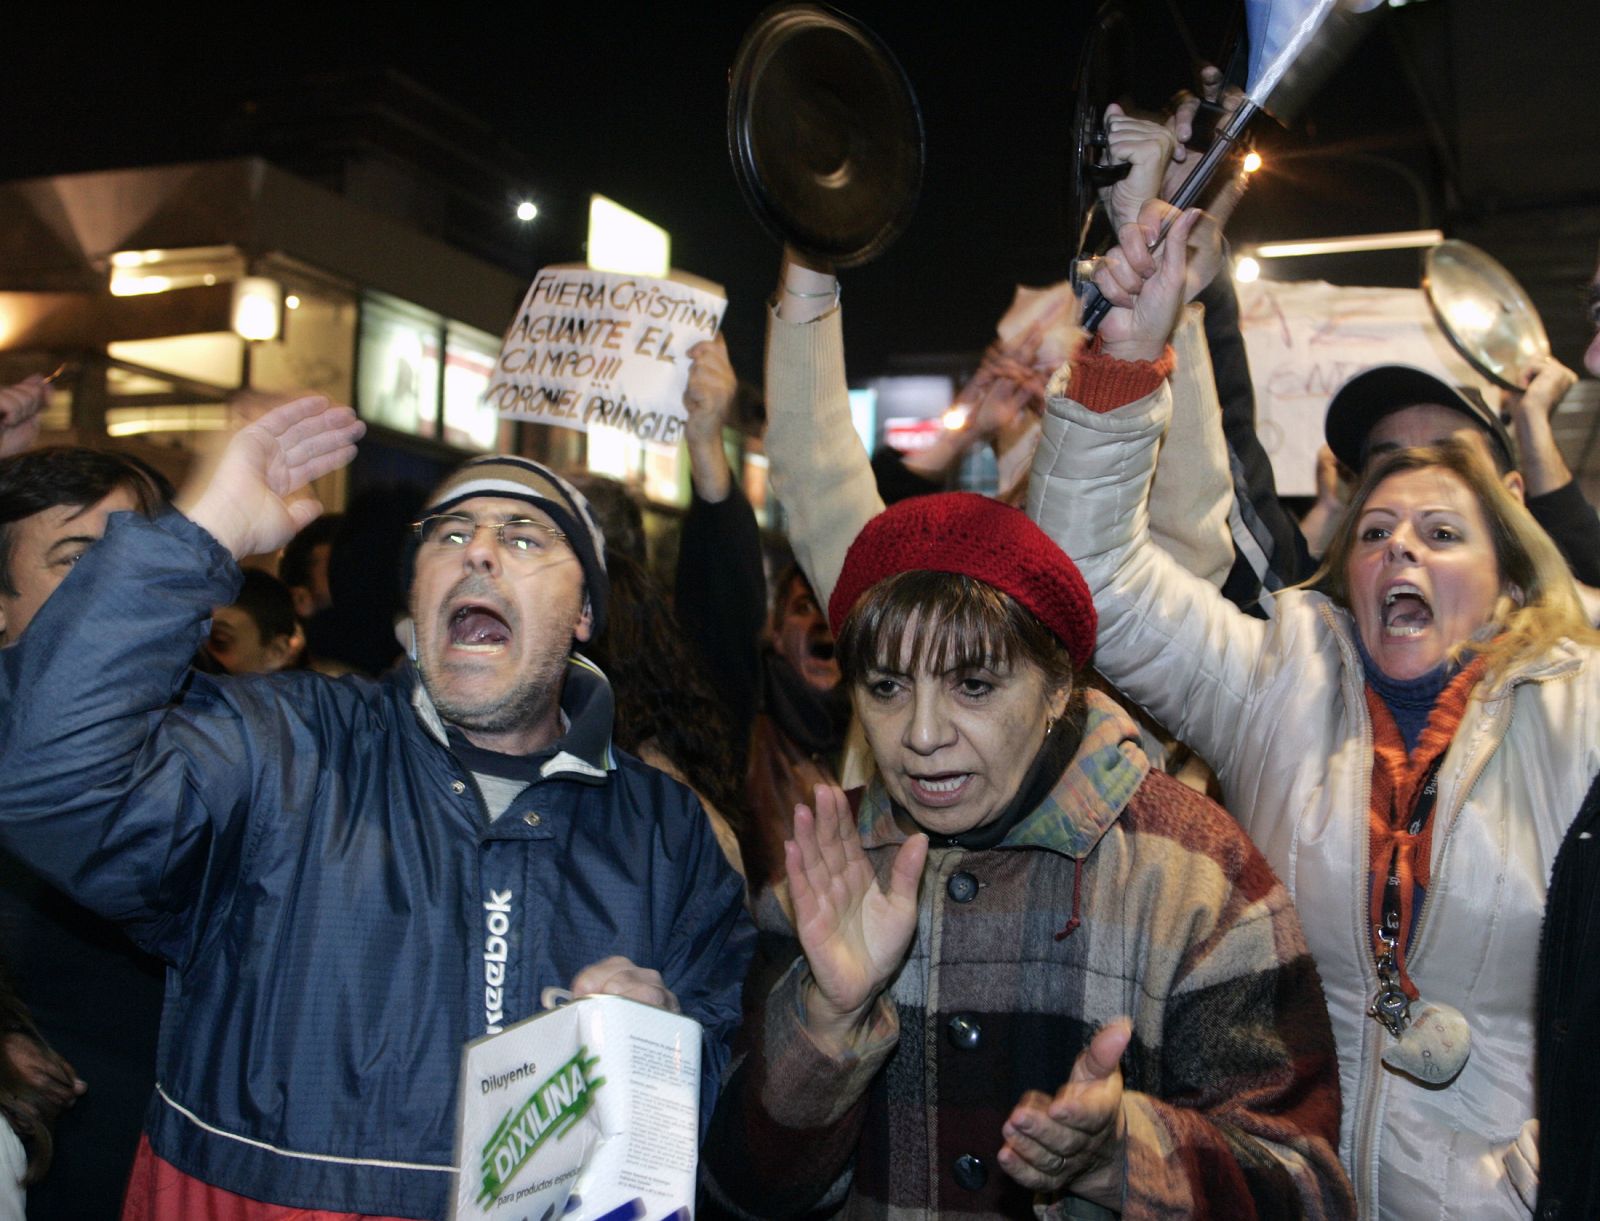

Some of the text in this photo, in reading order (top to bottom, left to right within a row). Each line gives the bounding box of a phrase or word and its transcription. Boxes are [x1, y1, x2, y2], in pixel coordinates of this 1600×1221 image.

[528, 276, 606, 309] FUERA
[510, 314, 676, 364] AGUANTE EL
[485, 383, 581, 418] CORONEL
[481, 1062, 536, 1095] Diluyente
[494, 1062, 587, 1184] DIXILINA
[498, 1193, 514, 1208] para
[516, 1179, 553, 1203] productos
